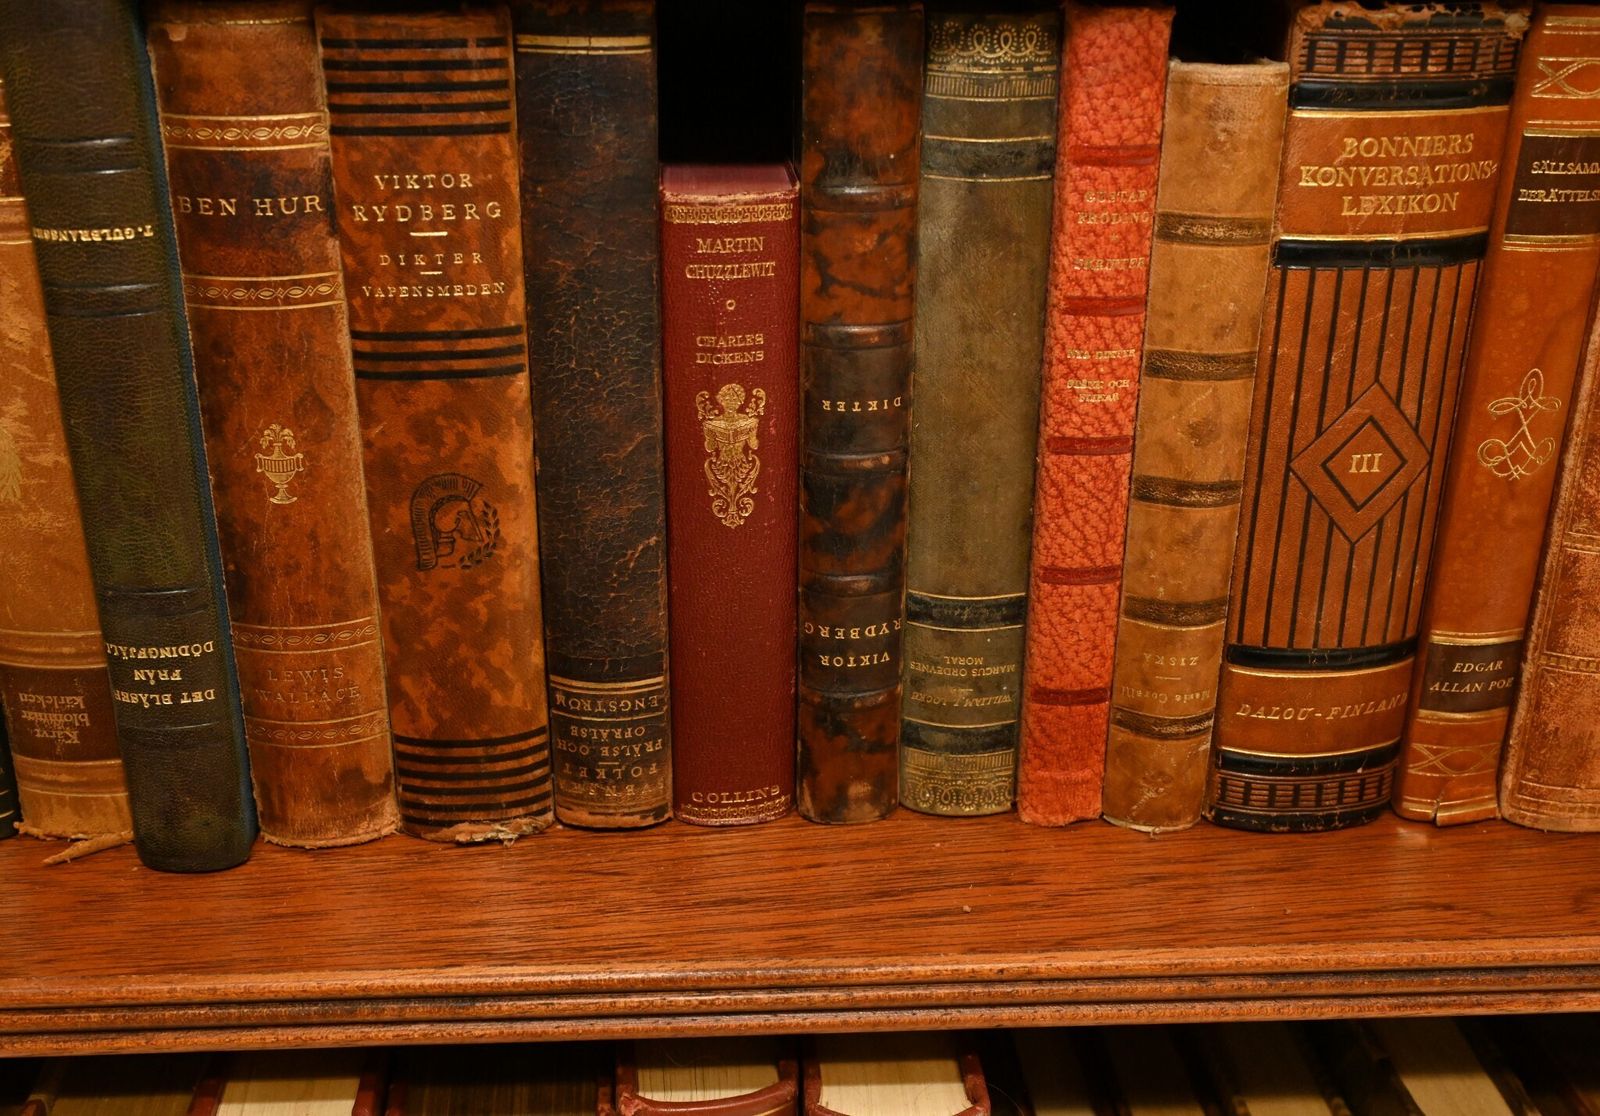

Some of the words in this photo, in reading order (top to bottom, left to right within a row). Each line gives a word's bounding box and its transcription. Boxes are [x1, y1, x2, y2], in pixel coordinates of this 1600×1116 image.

[1342, 132, 1474, 158] BONNIERS
[374, 173, 473, 190] VIKTOR
[1518, 188, 1600, 202] BERÄTTELS
[177, 195, 237, 217] BEN
[253, 194, 326, 217] HUR
[353, 201, 501, 222] RYDBERG
[1341, 192, 1460, 216] LEXIKON
[696, 236, 765, 253] MARTIN
[379, 252, 483, 266] DIKTER
[685, 261, 776, 279] CHUZZLEWIT
[362, 282, 505, 297] VAPENSMEDEN
[696, 333, 764, 347] CHARLES
[696, 350, 764, 365] DICKENS
[821, 396, 902, 412] DIKTER
[1349, 452, 1383, 473] III
[804, 617, 901, 640] RYDBERG
[818, 651, 890, 667] VIKTOR
[943, 655, 984, 666] MORAL
[1143, 652, 1200, 667] ZISKA
[1452, 660, 1504, 673] EDGAR
[134, 669, 182, 685] FRÅN
[267, 667, 345, 682] LEWIS
[910, 661, 968, 677] ORDEYNES
[972, 663, 1016, 677] MARCUS
[1429, 681, 1484, 693] ALLAN
[1488, 677, 1514, 691] POE
[180, 688, 215, 704] DET
[555, 692, 659, 713] ENGSTRÖM
[570, 726, 646, 742] OFRÄLSE
[556, 738, 590, 756] OCH
[563, 762, 658, 779] FOLKET
[691, 784, 780, 804] COLLINS
